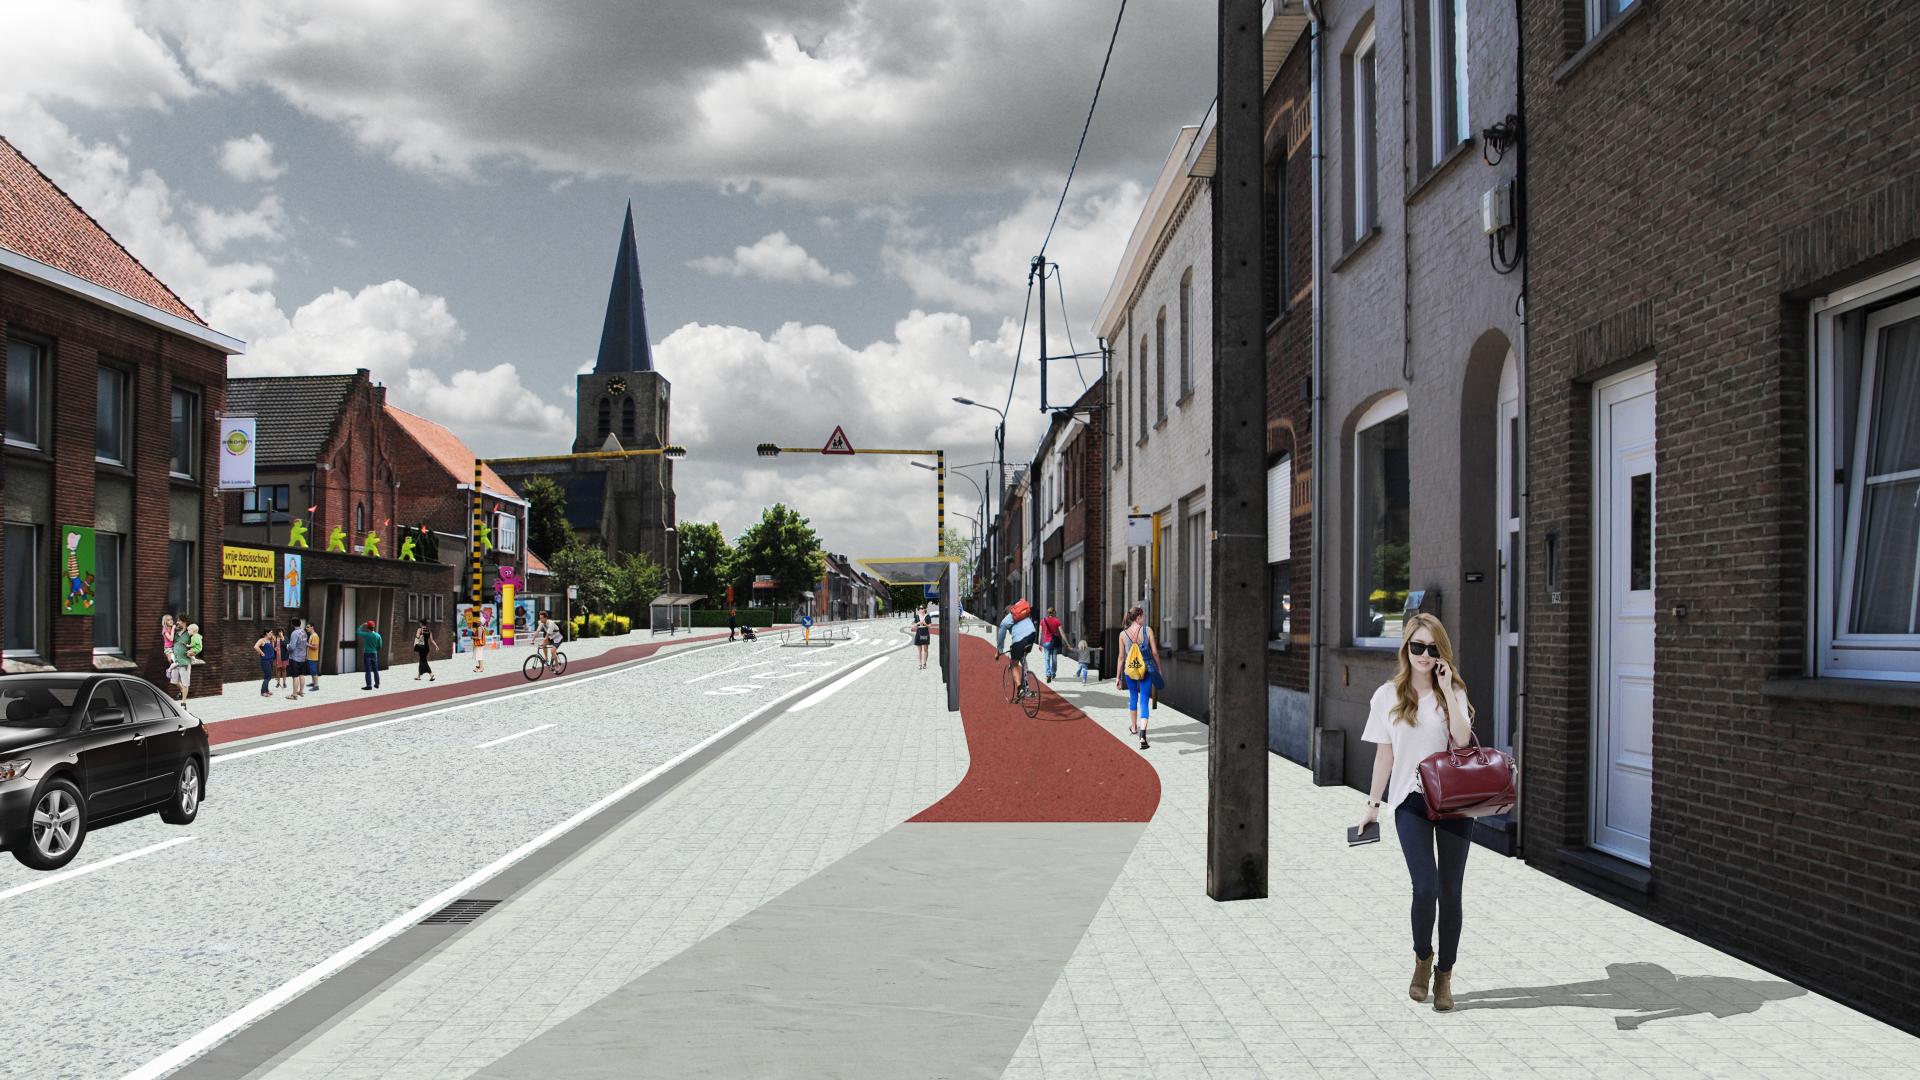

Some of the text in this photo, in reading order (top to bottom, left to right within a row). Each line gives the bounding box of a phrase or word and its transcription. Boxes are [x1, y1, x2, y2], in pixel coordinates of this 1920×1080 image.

[225, 550, 270, 564] vrije basisschool
[223, 563, 273, 579] INT-LODEWIJK
